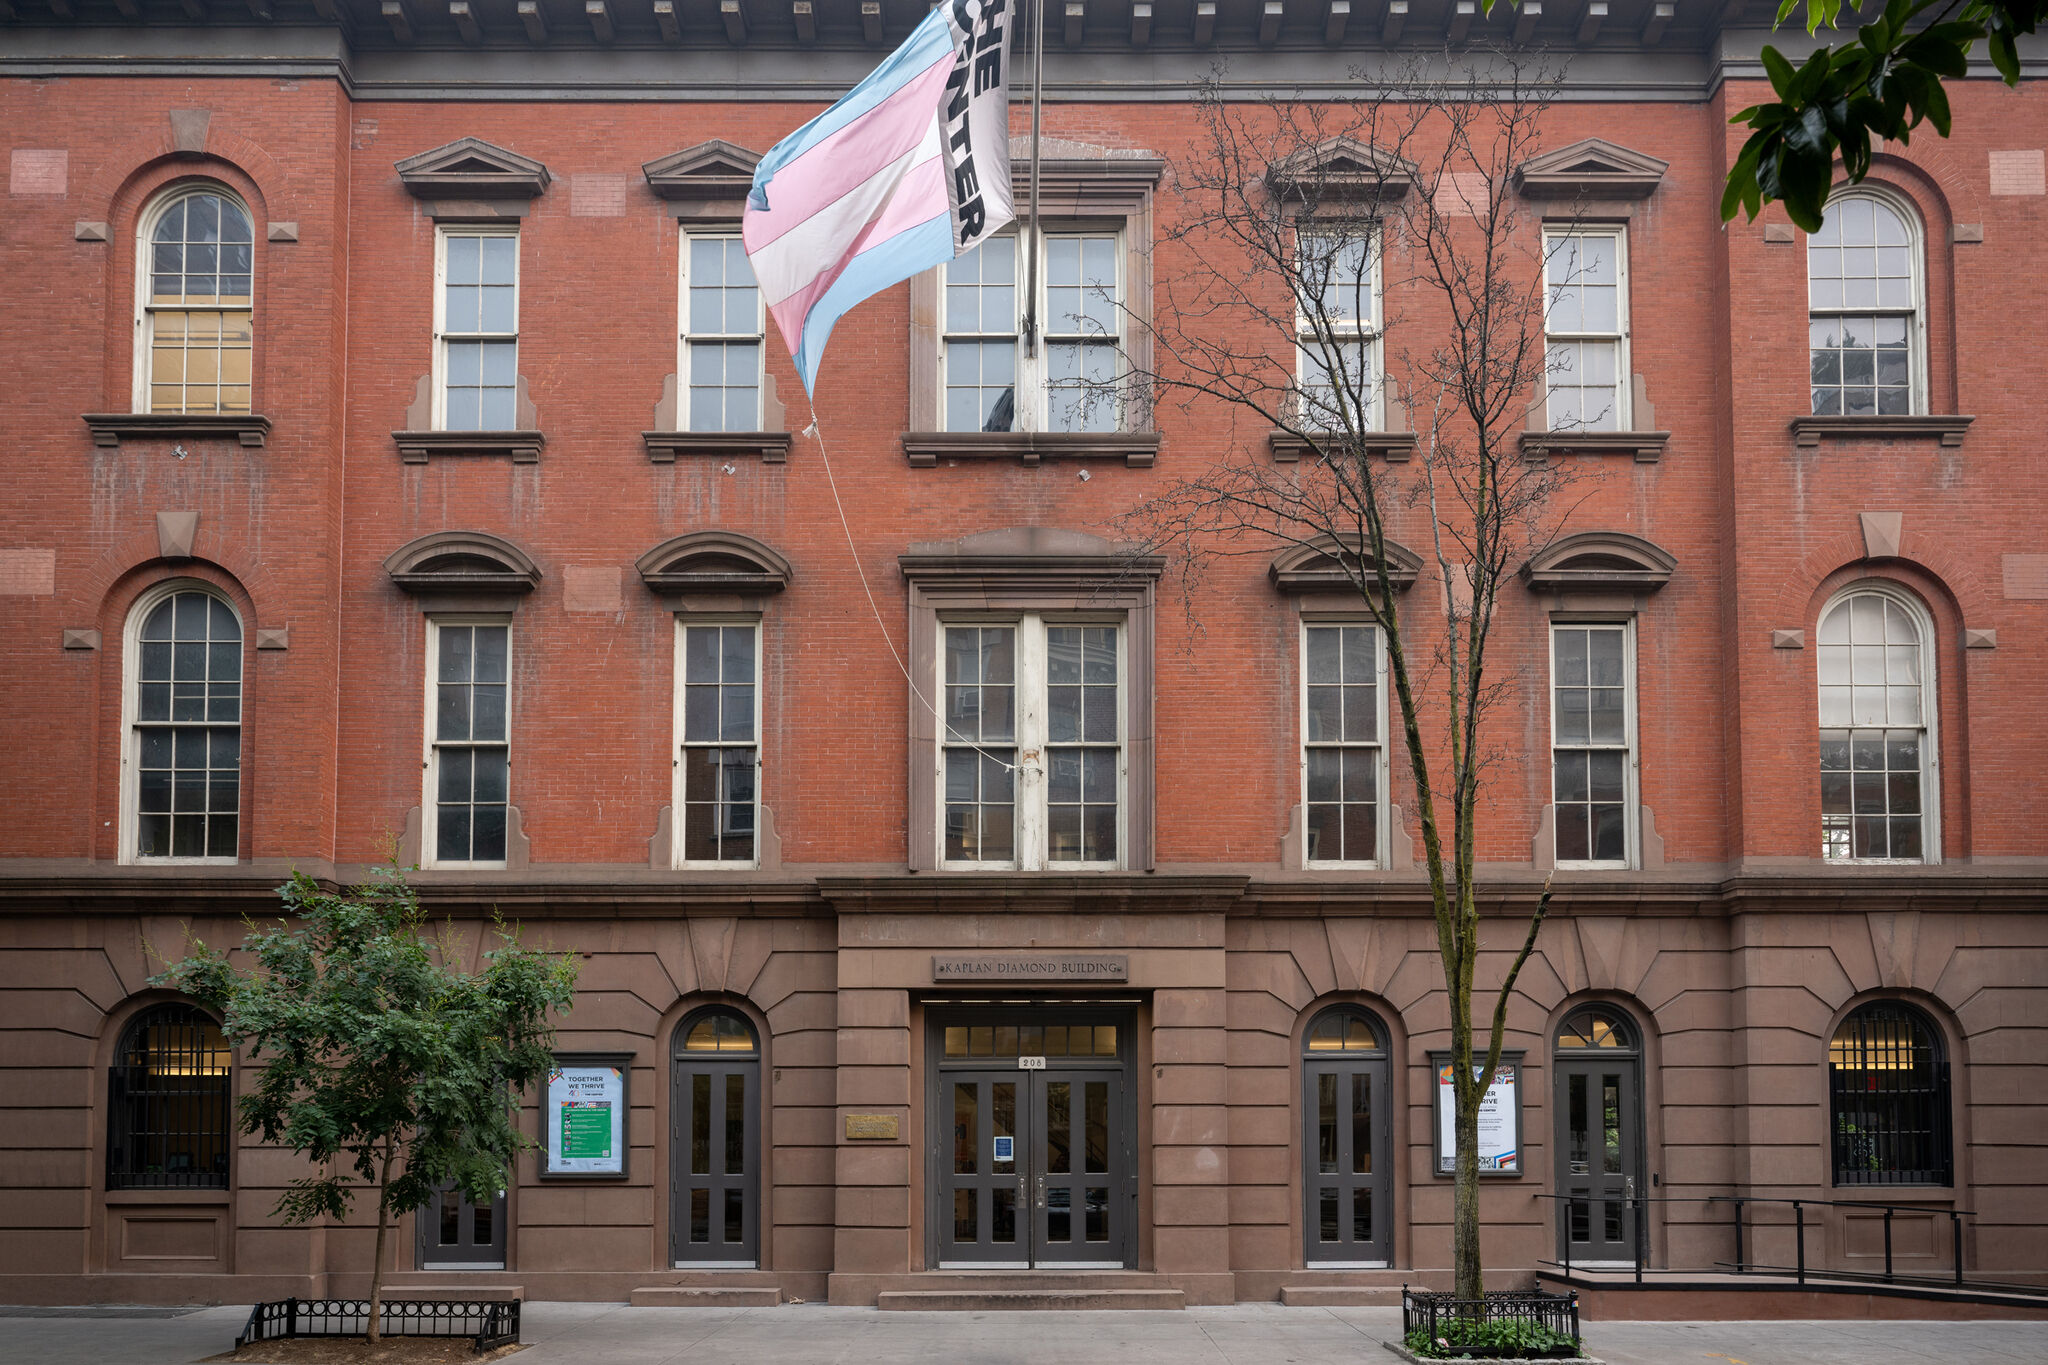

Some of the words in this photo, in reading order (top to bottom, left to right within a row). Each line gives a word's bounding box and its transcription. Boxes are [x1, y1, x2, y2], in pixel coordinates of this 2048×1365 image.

[974, 0, 1005, 98] HE
[945, 963, 992, 973] KAPLAN
[997, 963, 1057, 973] DIAMOND
[1061, 963, 1117, 973] BUILDING
[1023, 1059, 1042, 1067] 208
